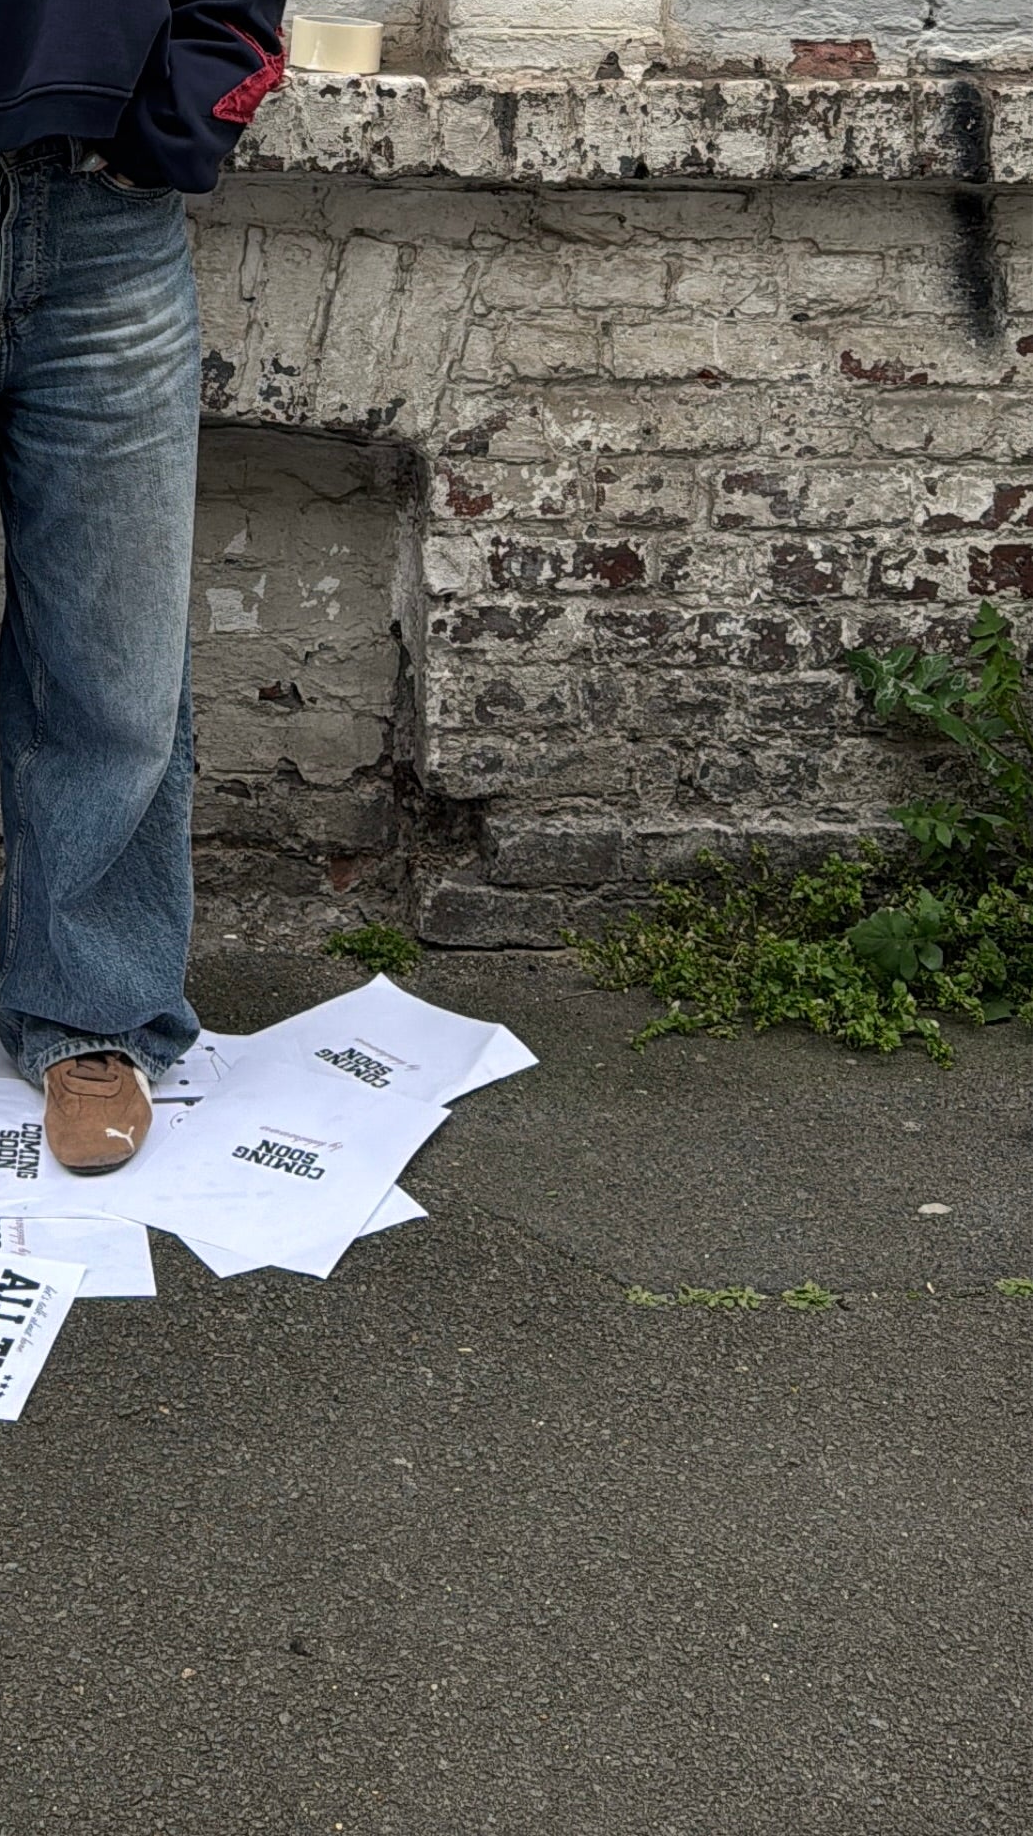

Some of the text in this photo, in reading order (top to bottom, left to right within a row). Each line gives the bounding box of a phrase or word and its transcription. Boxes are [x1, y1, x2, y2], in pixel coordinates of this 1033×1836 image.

[314, 1048, 391, 1089] COMING
[340, 1047, 394, 1077] SOON
[16, 1122, 42, 1179] COMING
[231, 1145, 325, 1180] COMING
[256, 1139, 319, 1165] SOON
